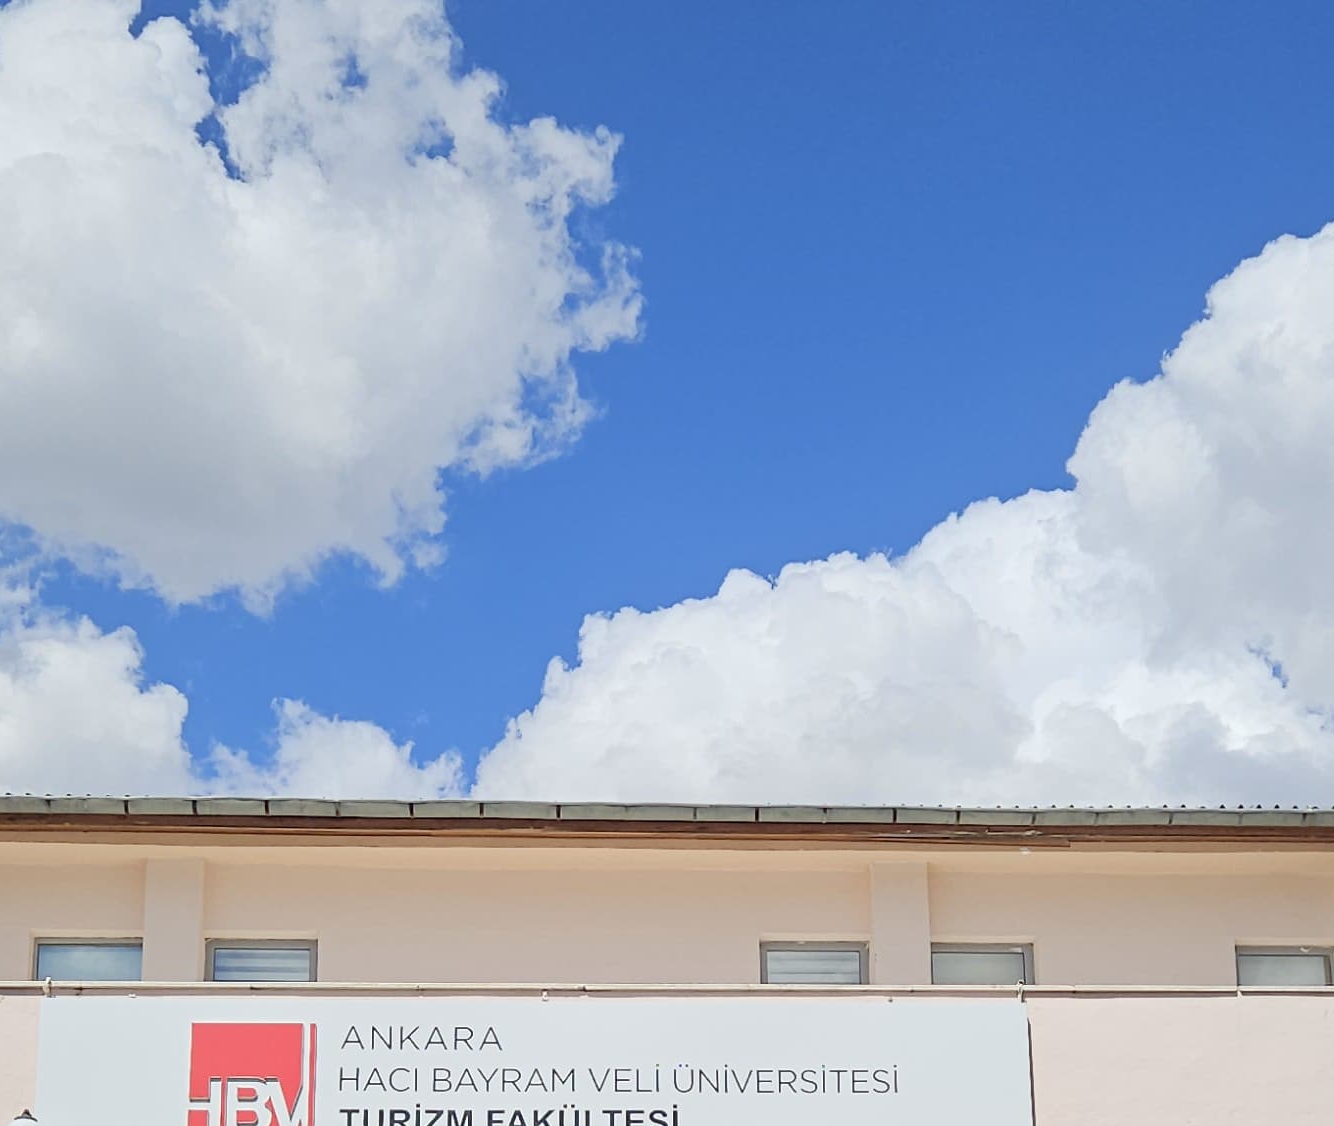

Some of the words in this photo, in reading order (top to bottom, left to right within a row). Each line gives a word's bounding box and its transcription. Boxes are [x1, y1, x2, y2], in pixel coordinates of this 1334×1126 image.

[340, 1025, 503, 1051] ANKARA
[338, 1066, 418, 1093] HACI
[431, 1066, 577, 1094] BAYRAM
[588, 1063, 660, 1094] VELİ
[672, 1063, 899, 1095] ÜNİVERSİTESİ
